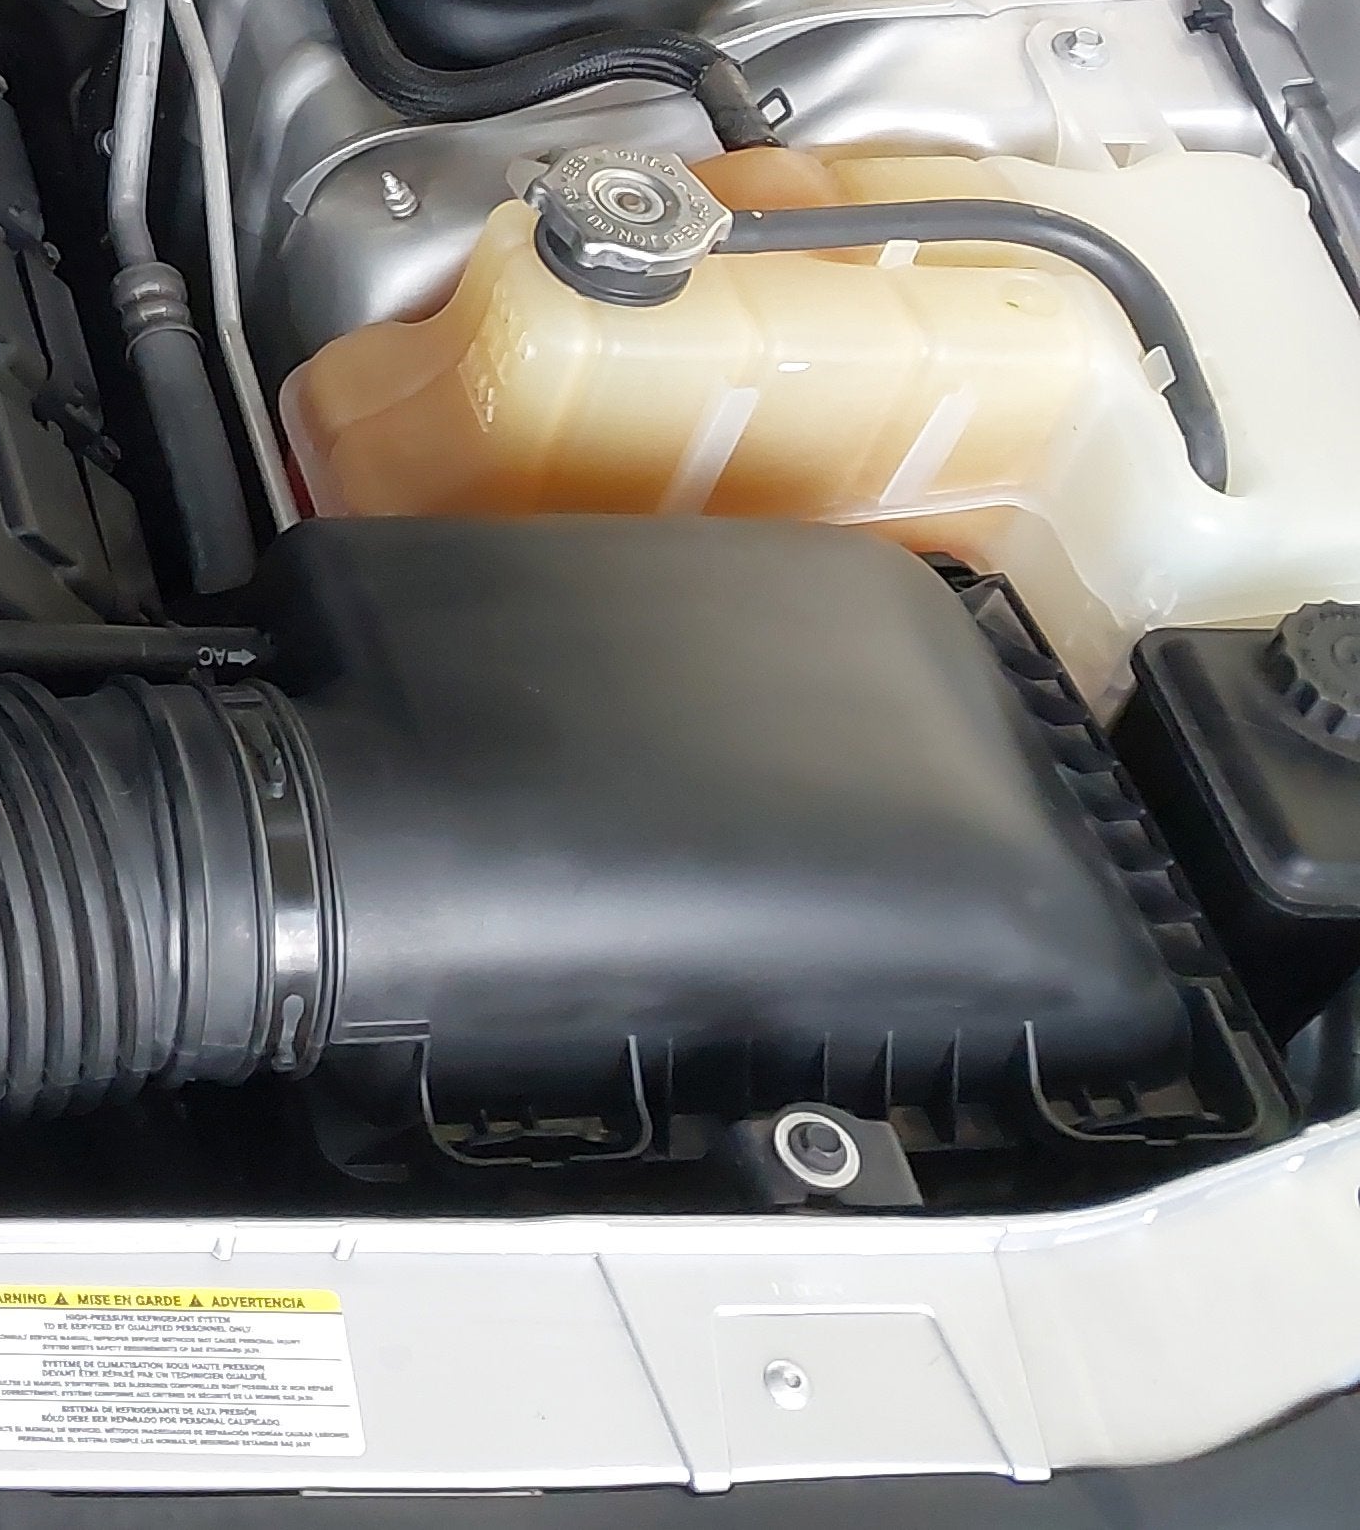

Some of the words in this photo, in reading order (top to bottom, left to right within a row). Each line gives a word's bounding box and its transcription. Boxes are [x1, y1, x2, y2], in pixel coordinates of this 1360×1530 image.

[78, 1294, 111, 1306] MISE
[114, 1295, 132, 1306] EN
[135, 1295, 182, 1307] GARDE
[212, 1297, 306, 1308] ADVERTENCIA
